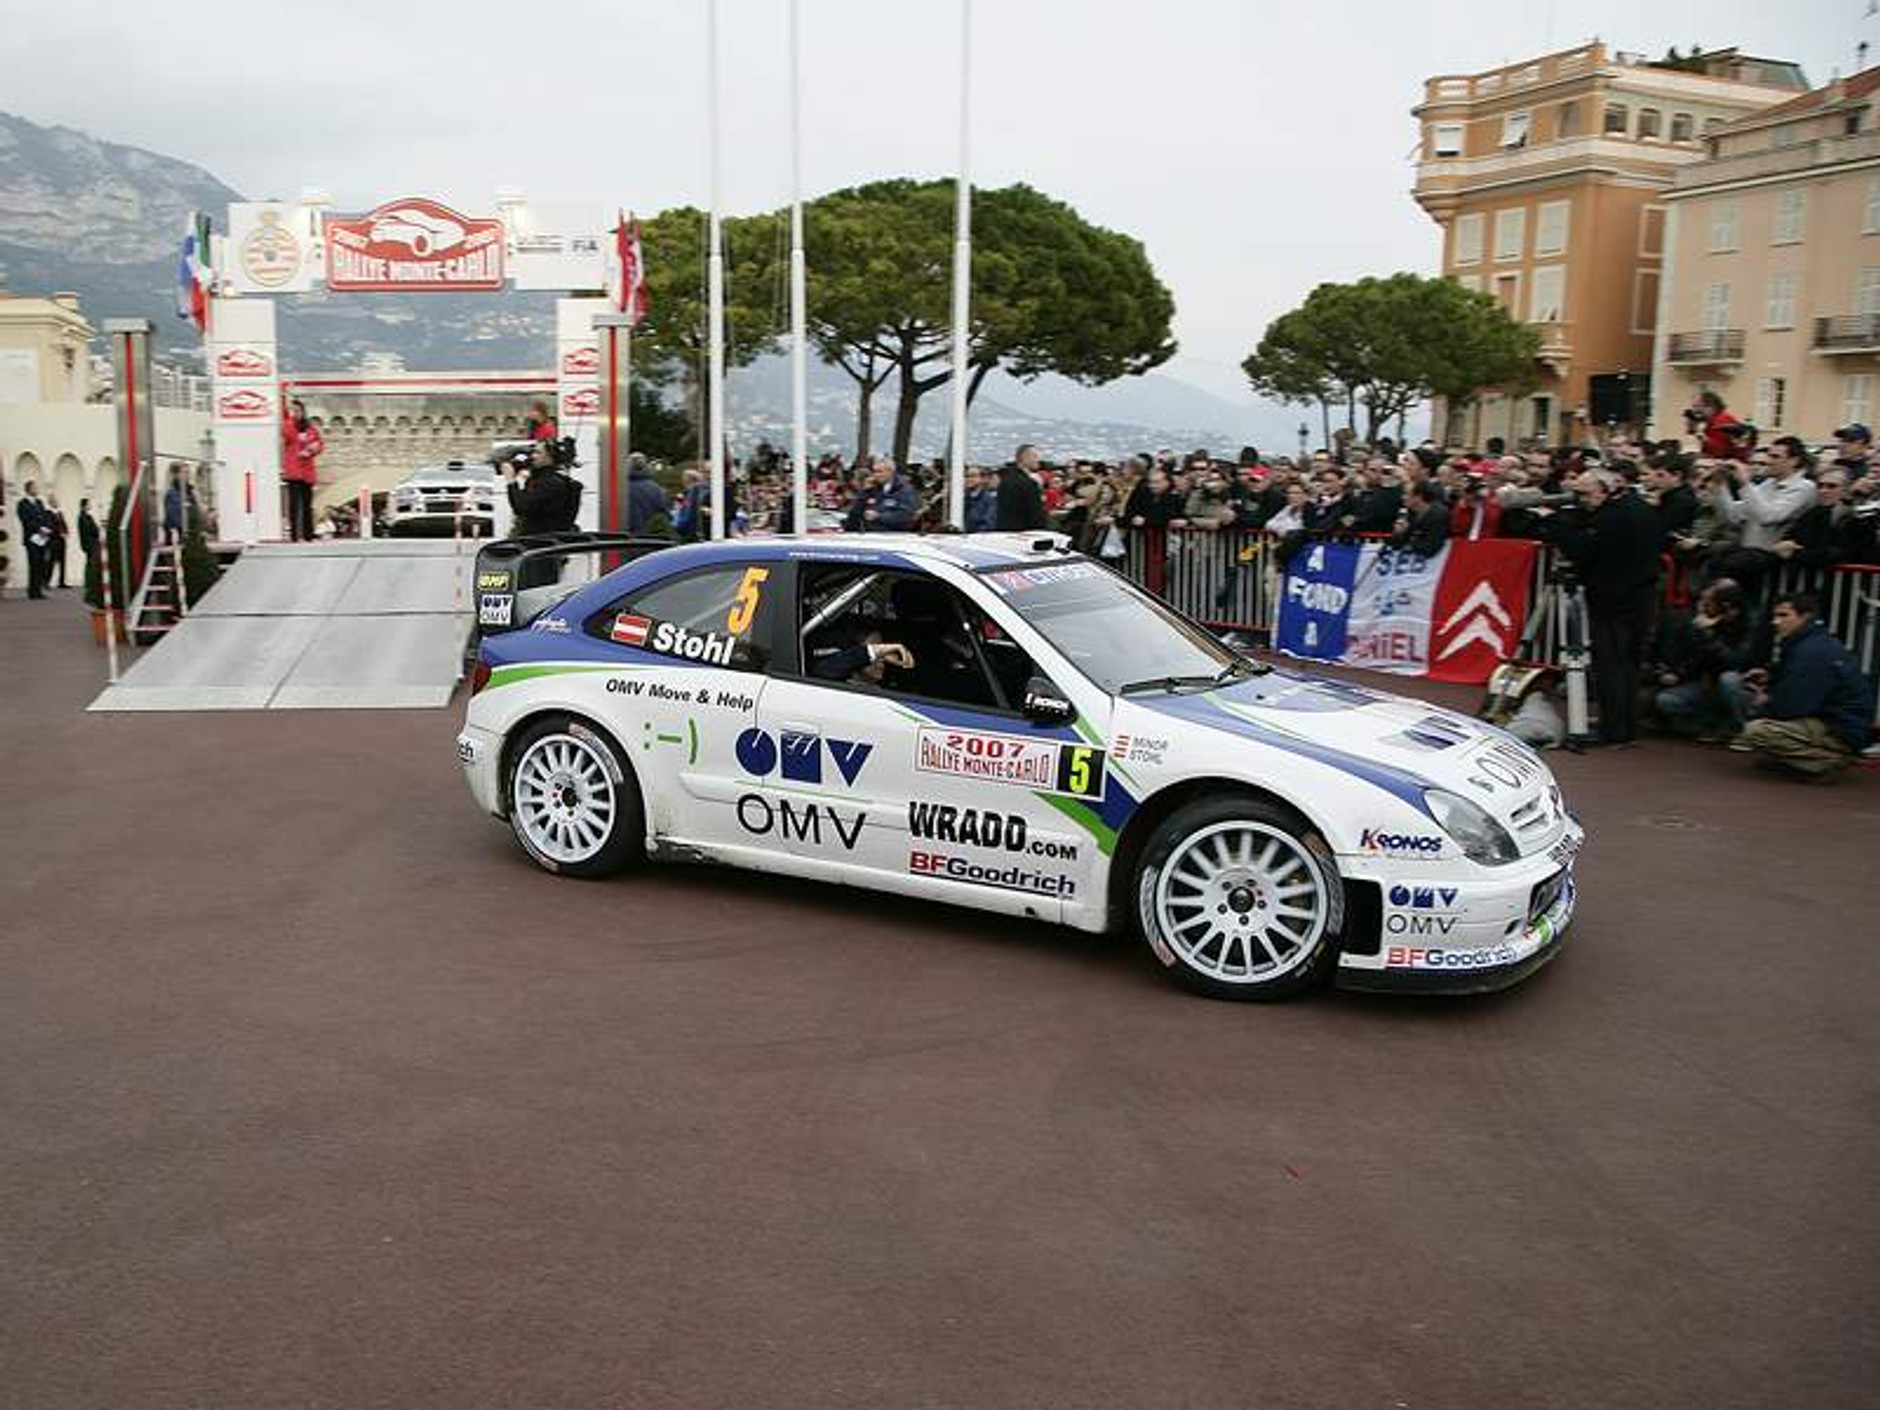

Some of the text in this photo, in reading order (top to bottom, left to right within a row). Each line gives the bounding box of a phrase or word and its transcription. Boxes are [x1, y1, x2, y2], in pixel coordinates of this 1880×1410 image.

[333, 246, 388, 281] RALLYE
[727, 566, 770, 634] 5
[653, 622, 736, 666] Stohl
[606, 678, 754, 712] OMV Move & Help
[921, 735, 1050, 785] RALLYE MONTE-CARLO
[946, 735, 1026, 759] 2007
[1068, 746, 1093, 795] 5
[738, 793, 867, 850] OMV
[909, 851, 1076, 895] BFGoodrich
[1387, 913, 1458, 935] OMV
